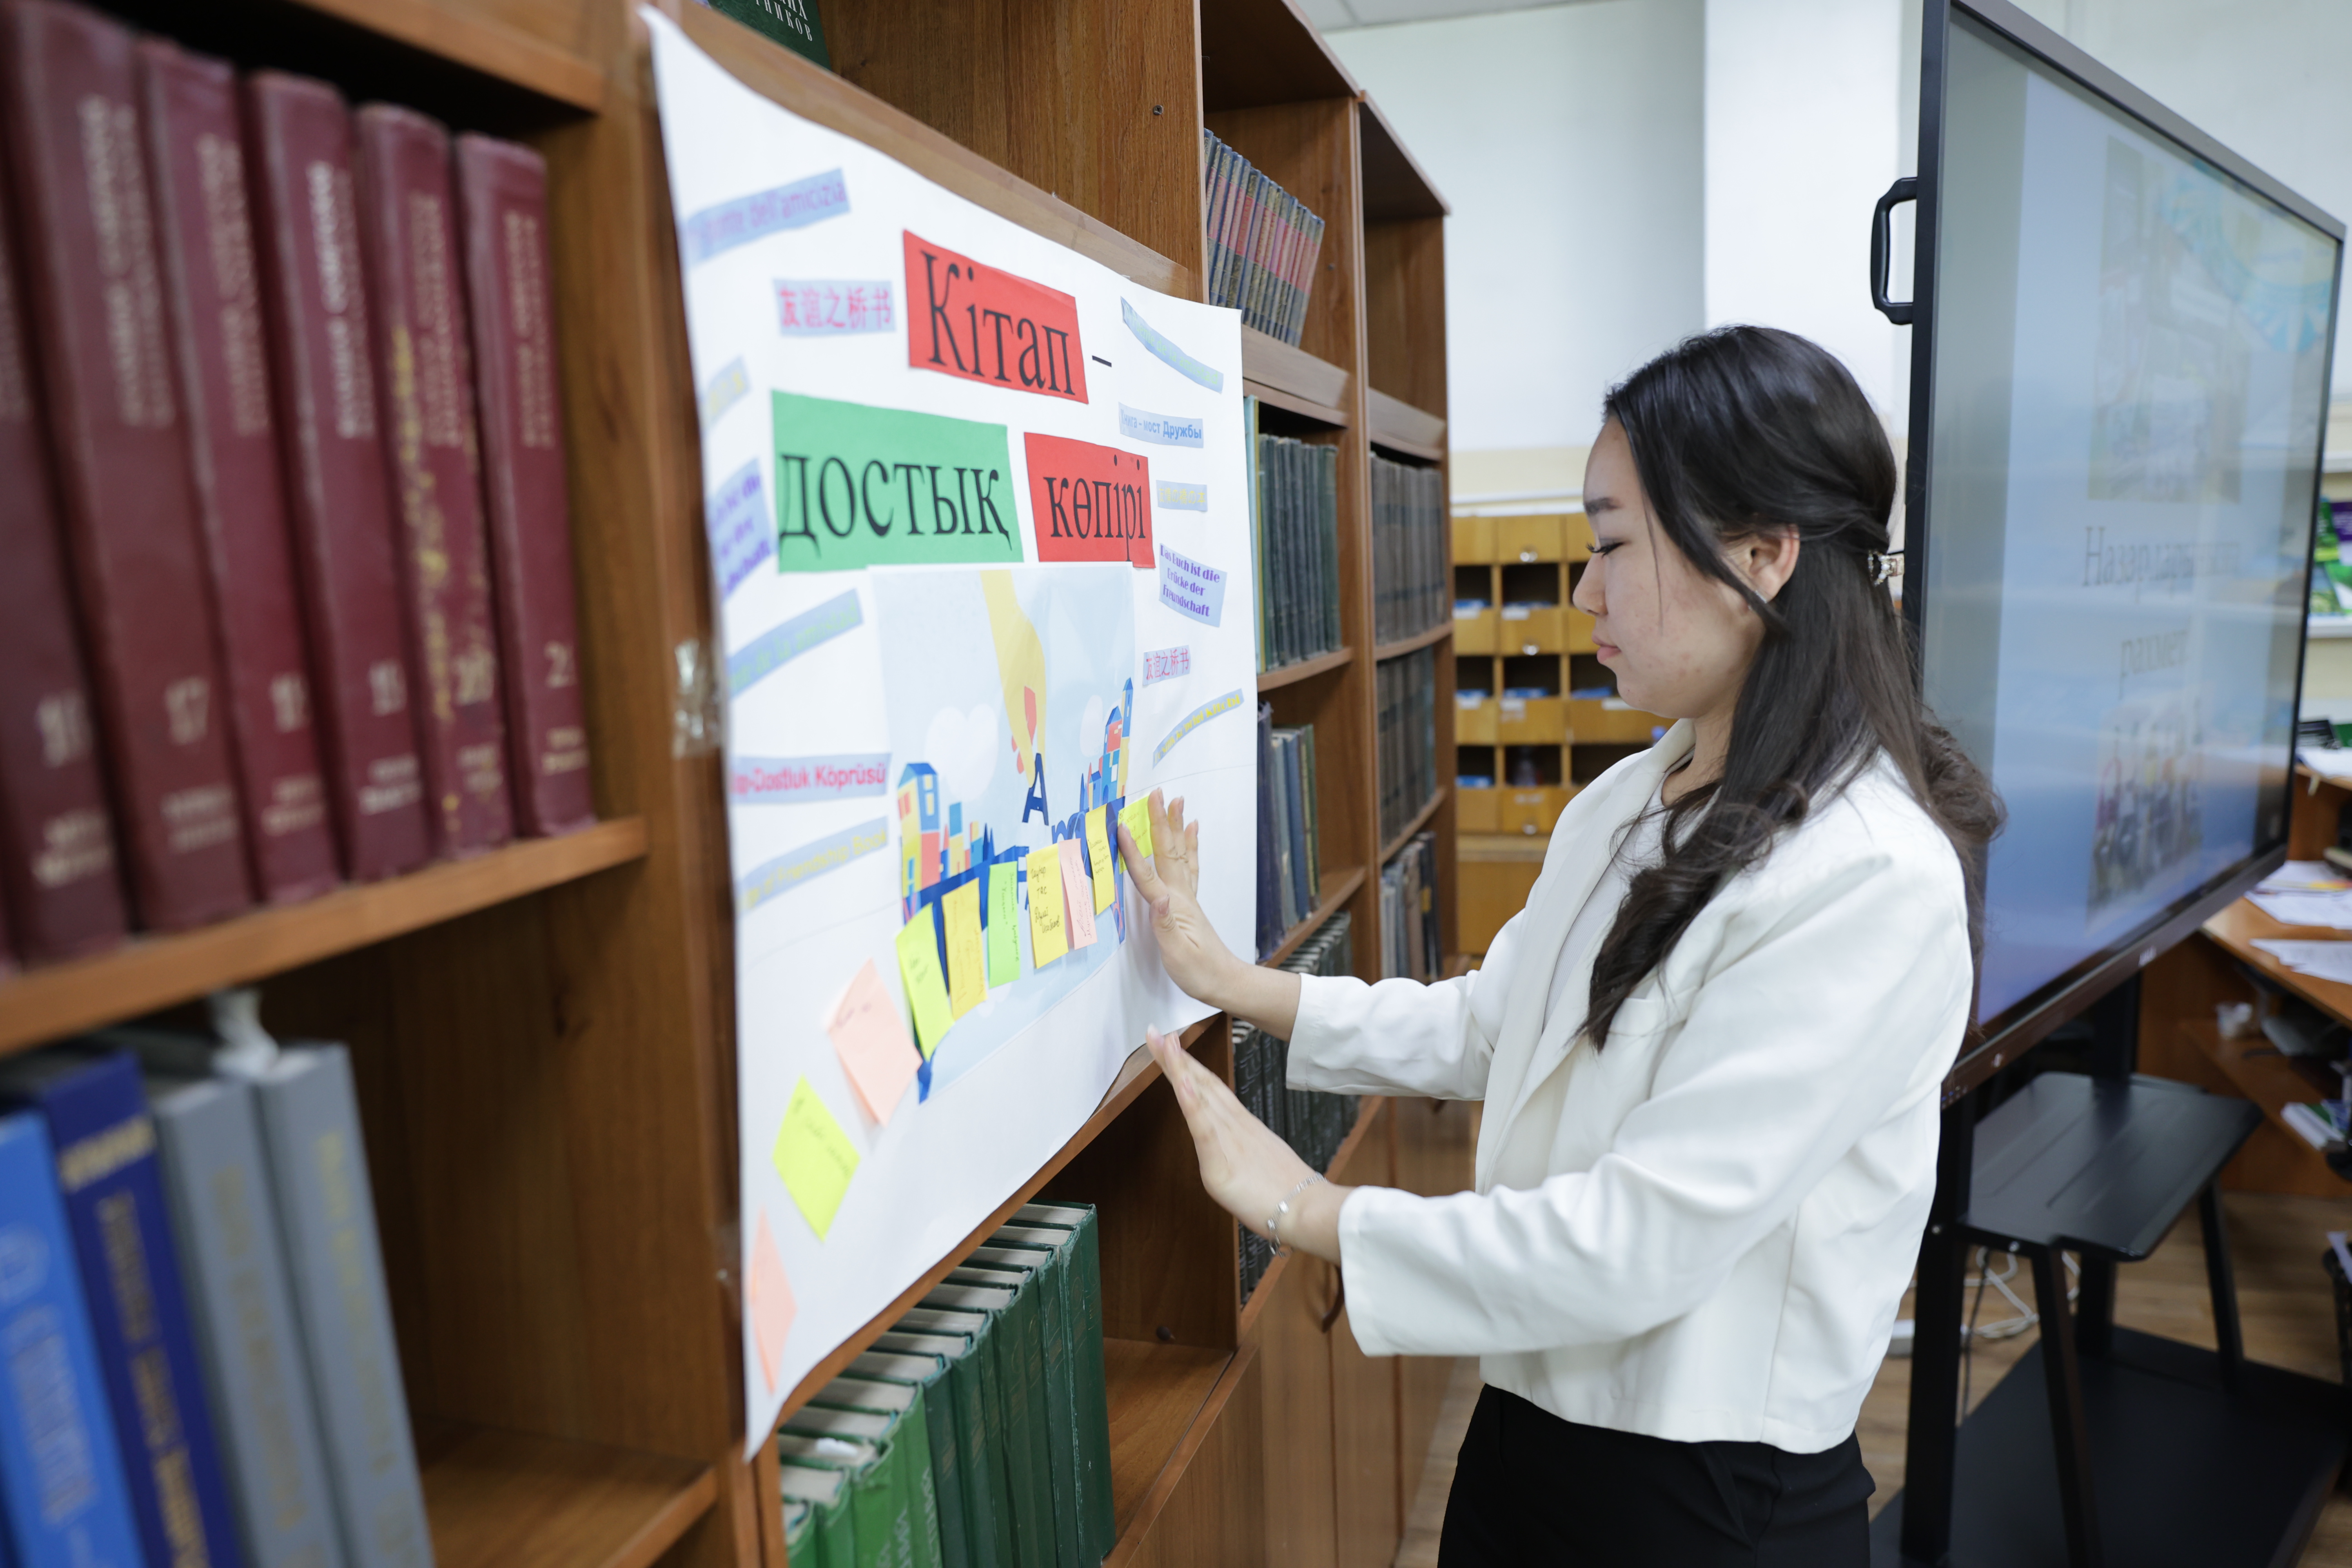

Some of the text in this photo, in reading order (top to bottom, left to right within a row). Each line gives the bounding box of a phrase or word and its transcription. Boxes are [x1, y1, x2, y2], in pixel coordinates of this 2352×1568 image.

[756, 0, 813, 41] НИКОВ
[920, 250, 1075, 396] Кітап
[1157, 337, 1167, 356] de
[1180, 356, 1218, 385] amistad
[1121, 409, 1137, 428] Книга
[1143, 420, 1161, 434] мост
[1163, 421, 1202, 440] Дружбы
[780, 454, 1013, 558] достық
[1044, 455, 1146, 562] көпірі
[1160, 544, 1220, 583] Das Buch ist die
[1167, 567, 1206, 596] Brücke der
[1163, 584, 1210, 617] Freundschaft
[1146, 648, 1189, 680] 友谊之桥书
[814, 763, 887, 793] Köprüsü
[853, 828, 886, 855] Book
